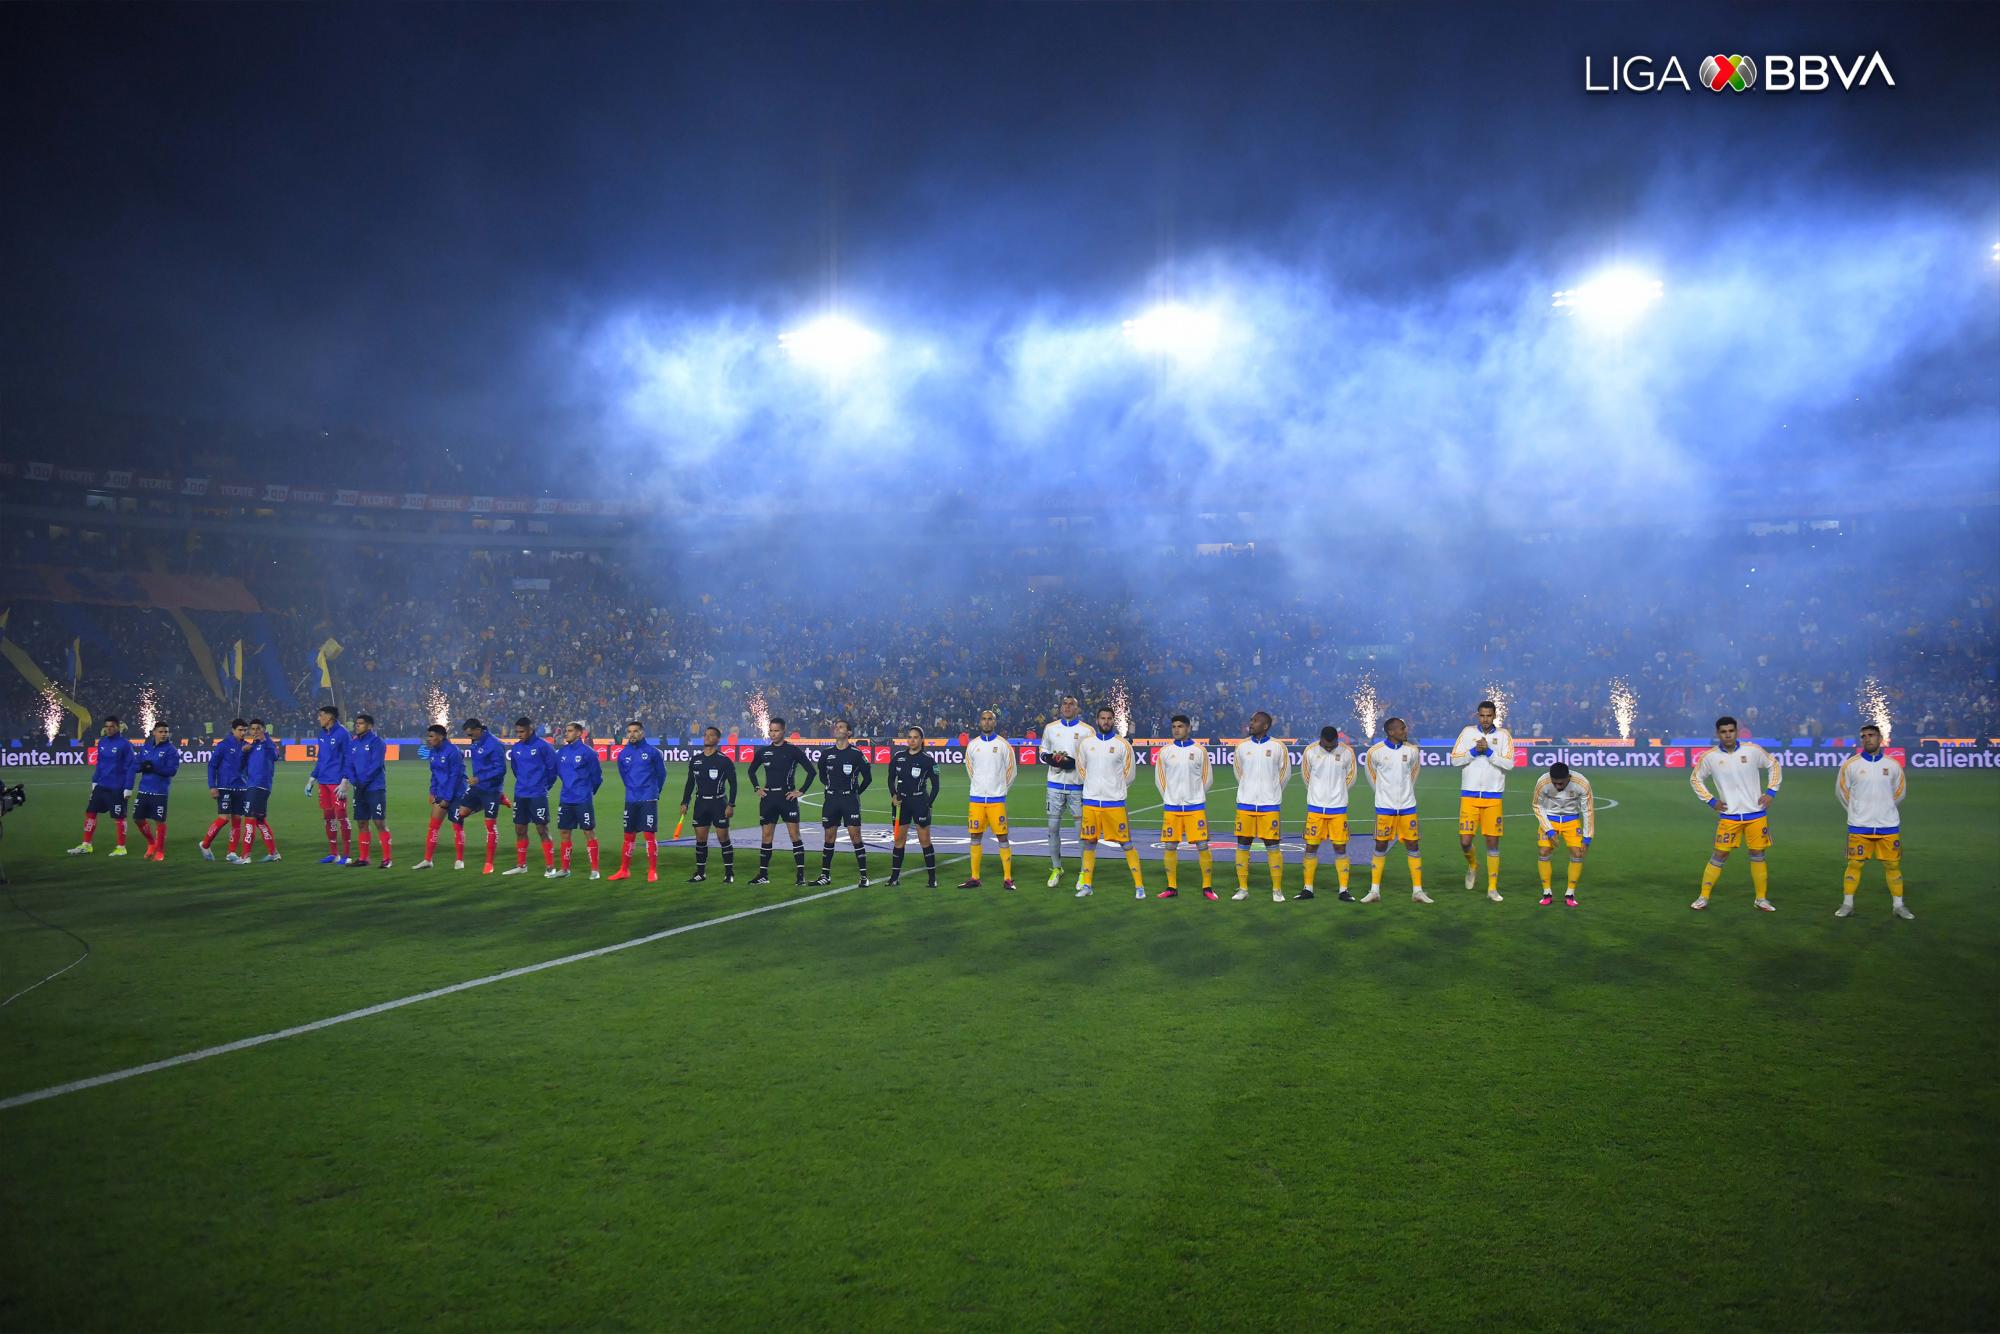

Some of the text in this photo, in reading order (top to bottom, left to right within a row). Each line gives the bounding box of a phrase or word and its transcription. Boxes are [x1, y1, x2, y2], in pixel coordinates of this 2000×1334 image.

[1531, 748, 1661, 767] caliente.mx
[969, 820, 979, 829] 19
[1464, 820, 1475, 831] 13
[1166, 827, 1173, 838] 9
[1310, 826, 1317, 836] 5
[1723, 832, 1736, 843] 27
[1857, 844, 1864, 856] 8
